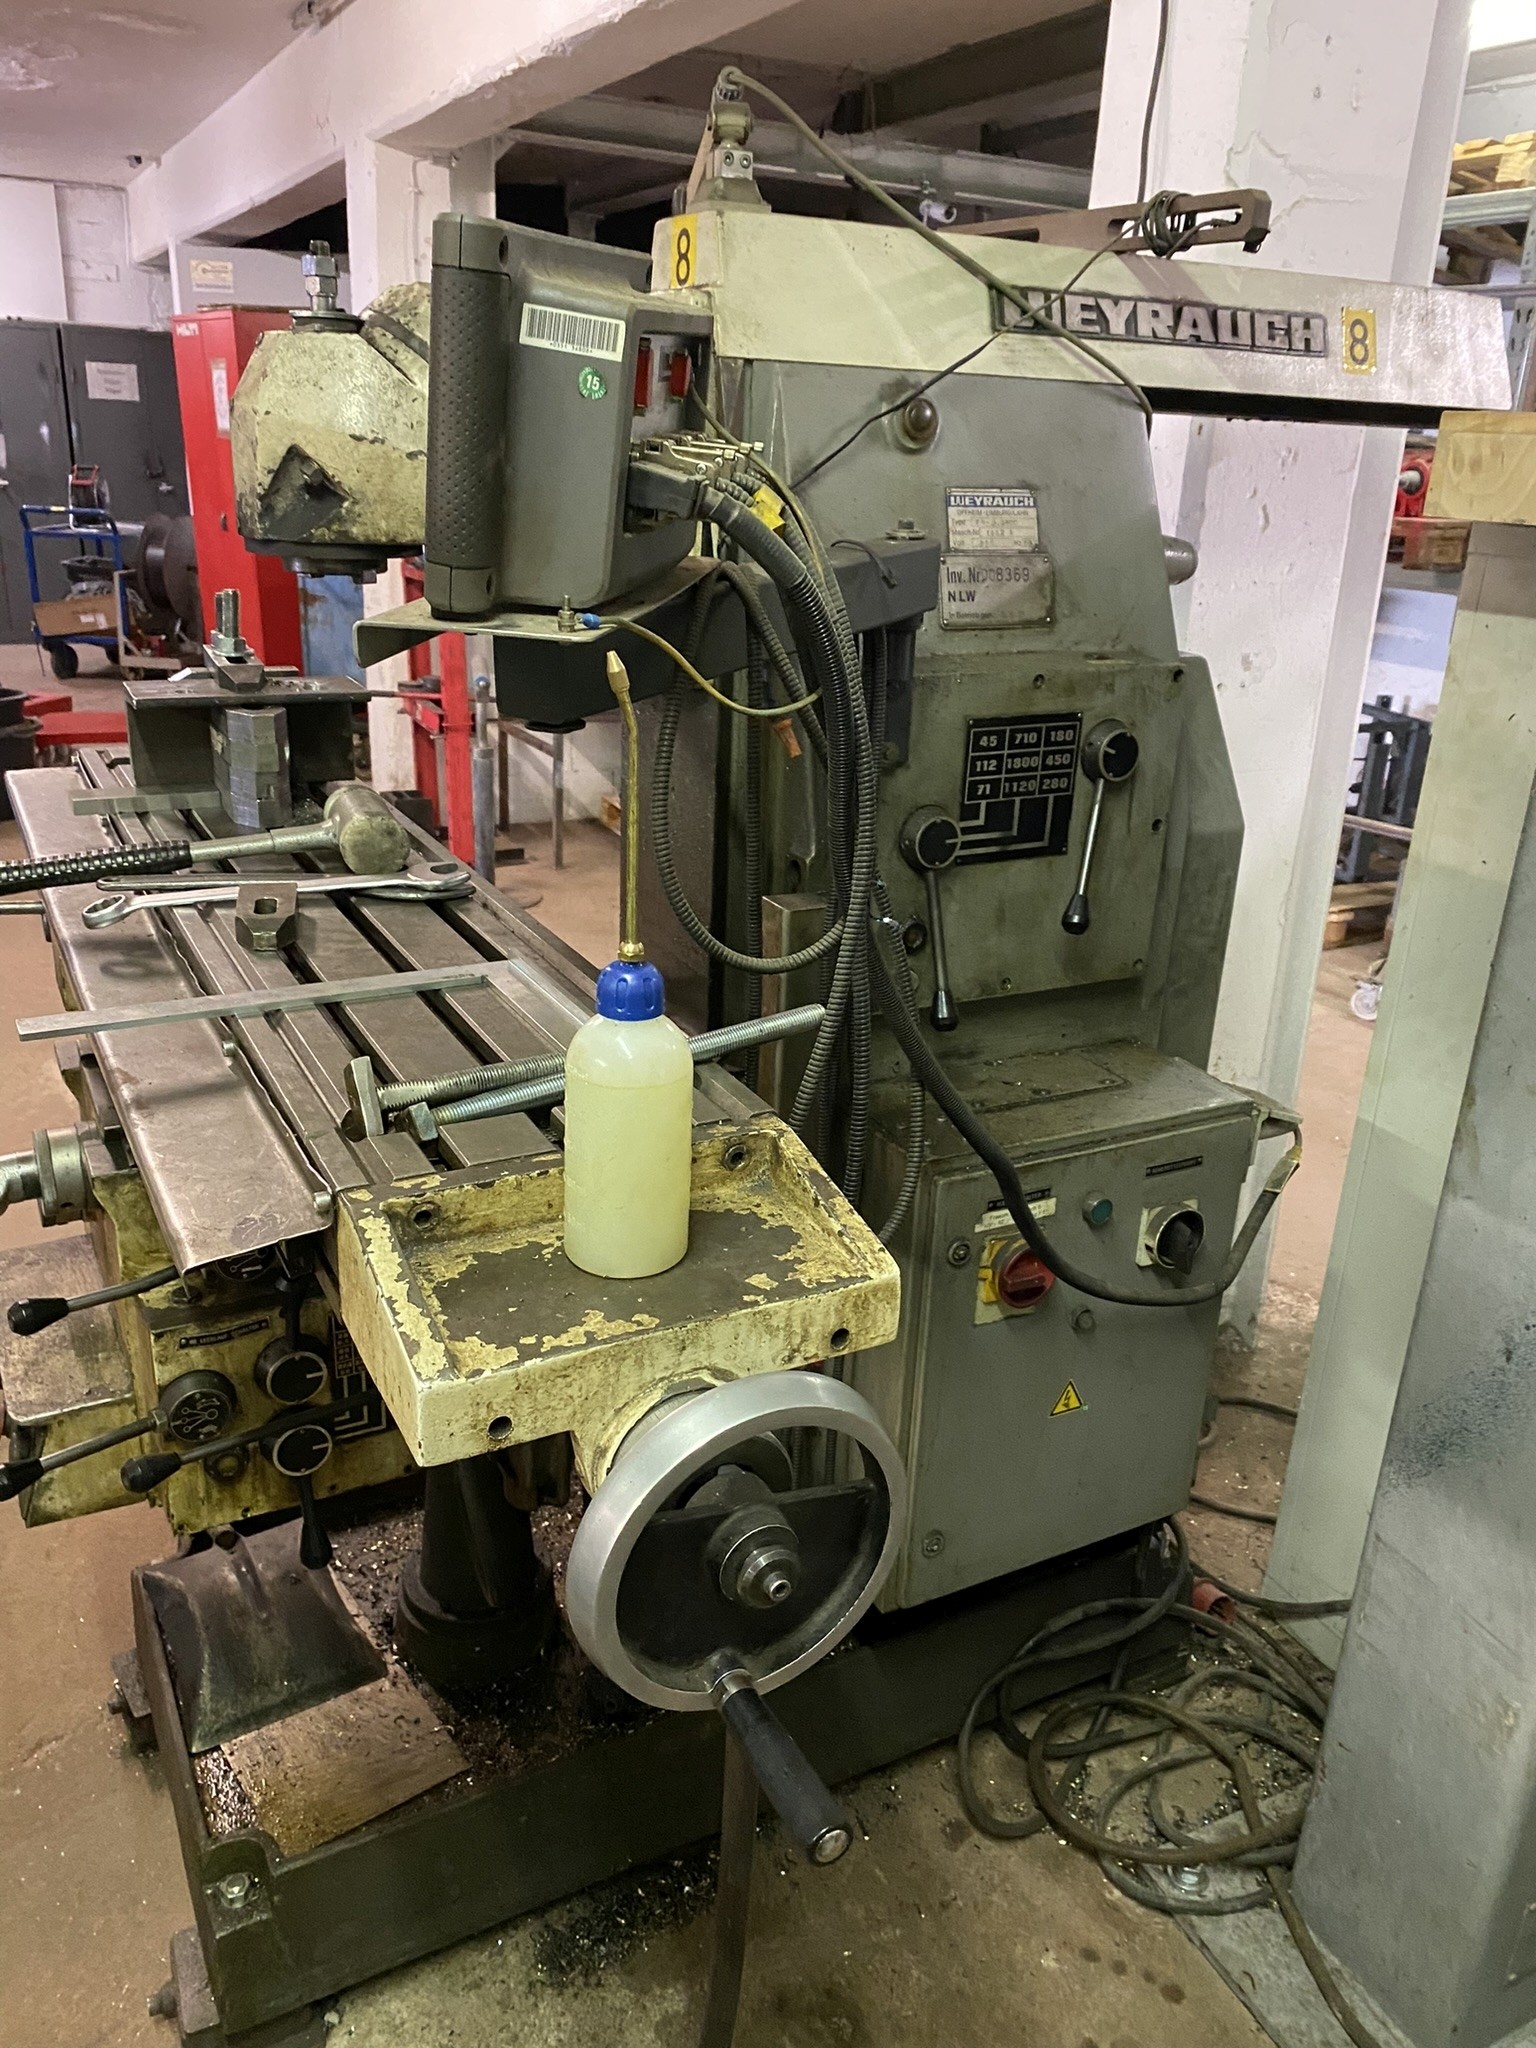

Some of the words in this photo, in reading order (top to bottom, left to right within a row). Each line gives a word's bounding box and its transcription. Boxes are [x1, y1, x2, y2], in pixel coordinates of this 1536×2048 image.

[676, 227, 691, 286] 8
[1349, 318, 1370, 365] 8
[586, 374, 600, 391] 15
[951, 496, 1034, 507] WEYRAUCH
[979, 735, 998, 747] 45
[1014, 732, 1038, 744] 710
[1050, 730, 1074, 741] 180
[975, 760, 998, 772] 112
[1006, 756, 1039, 769] 1800
[1045, 753, 1071, 765] 450
[976, 784, 991, 795] 71
[1004, 780, 1037, 793] 1120
[1042, 778, 1068, 790] 280
